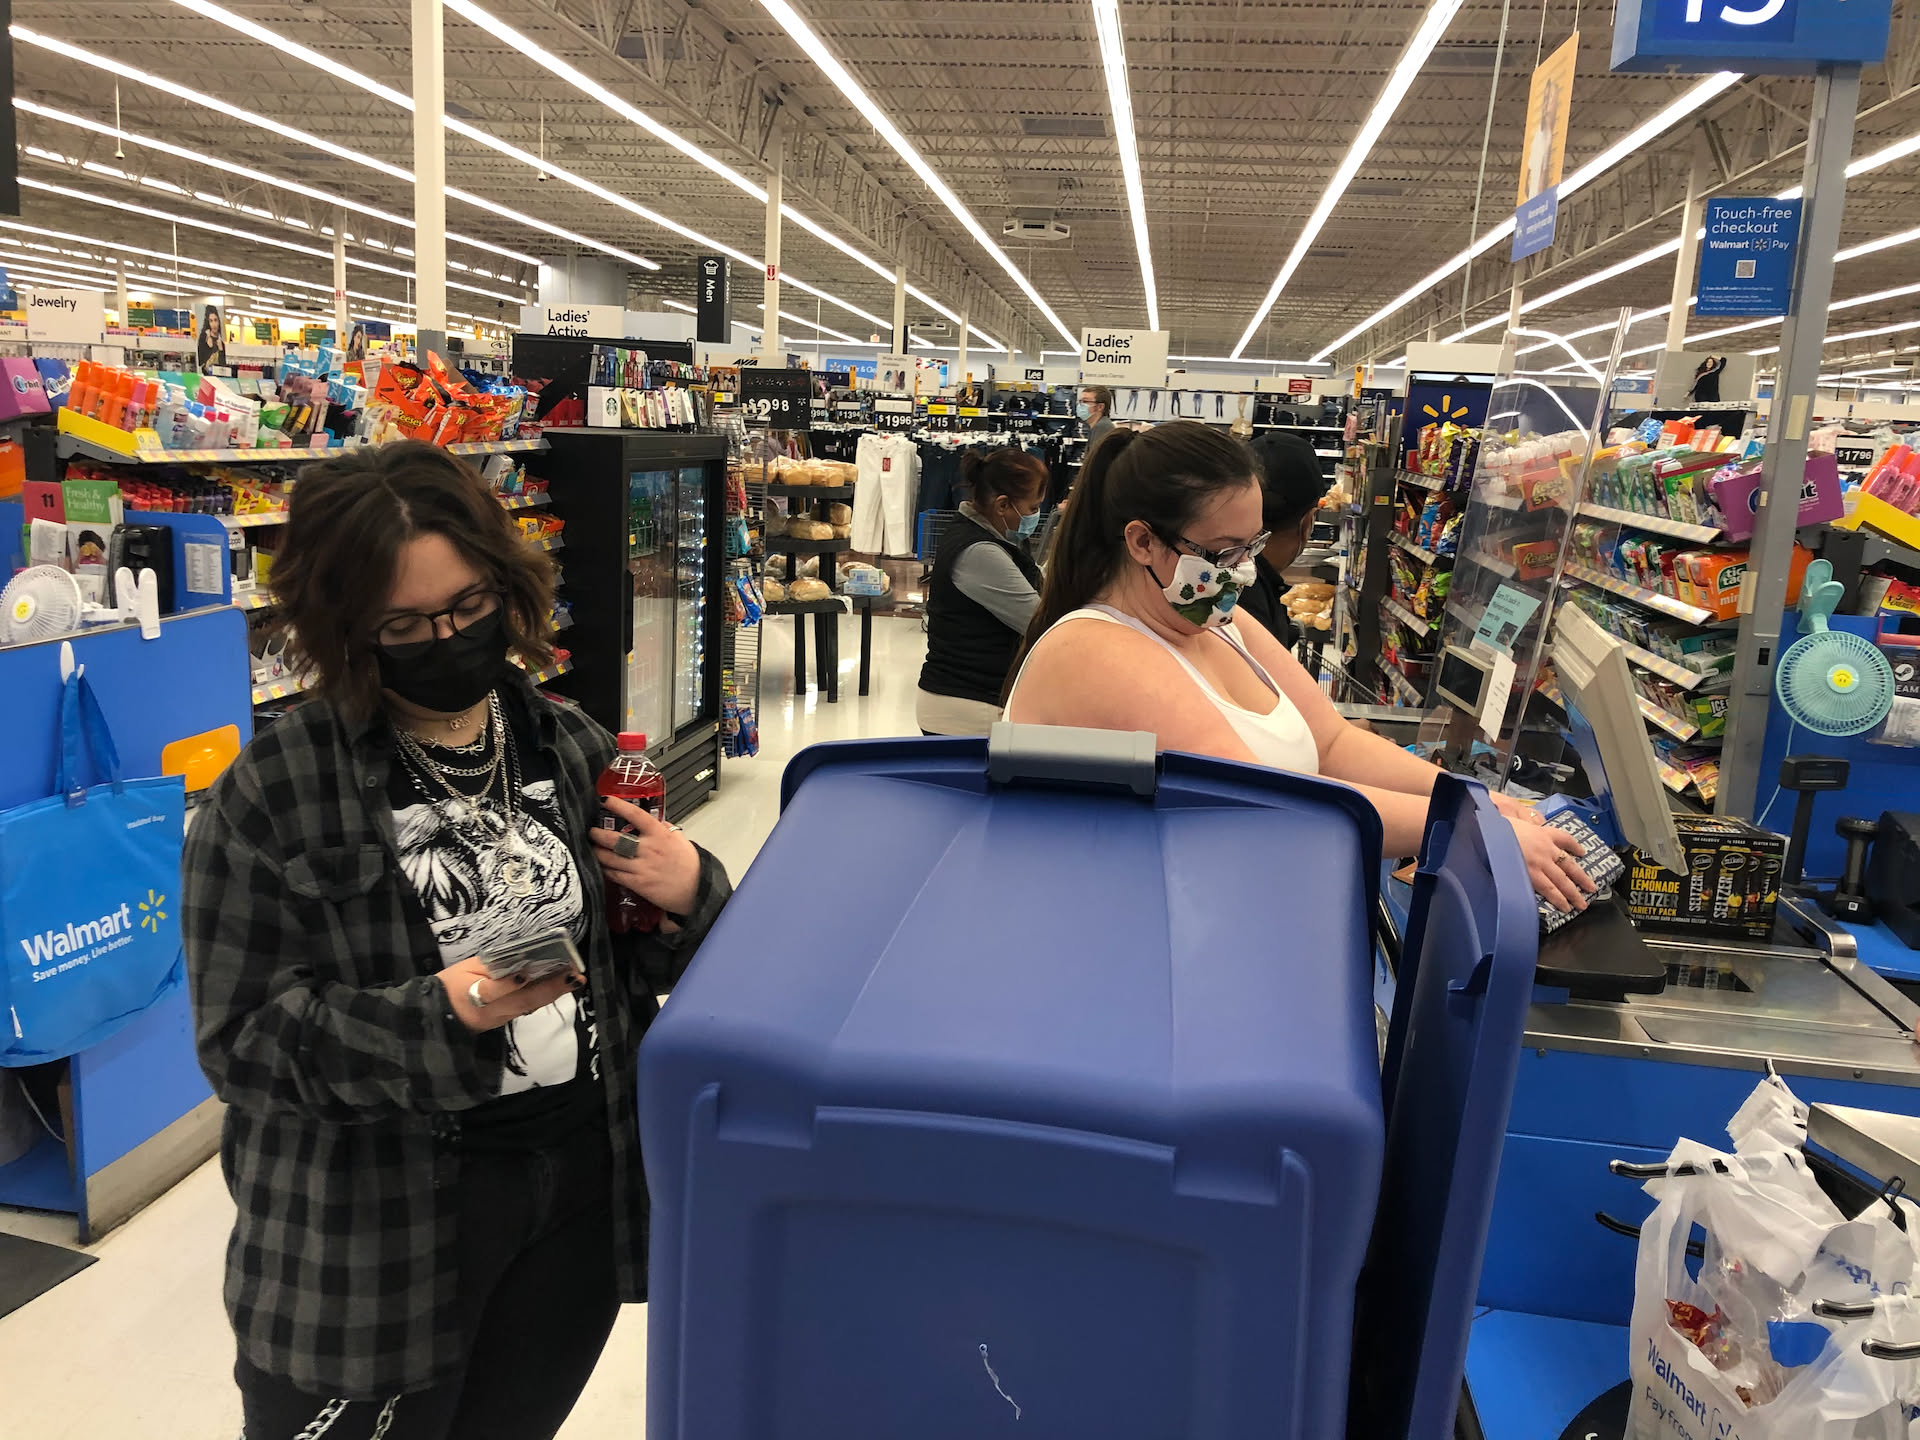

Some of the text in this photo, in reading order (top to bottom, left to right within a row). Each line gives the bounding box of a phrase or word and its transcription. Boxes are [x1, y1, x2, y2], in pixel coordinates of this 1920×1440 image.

[1713, 206, 1793, 219] Touch-free
[1711, 221, 1779, 234] checkout
[1709, 240, 1790, 251] Walmart Pay
[705, 278, 716, 303] Men
[30, 294, 77, 312] Jewelry
[547, 324, 589, 337] Active
[1085, 350, 1132, 365] Denim
[1026, 370, 1043, 380] Lee
[931, 416, 949, 429] $15
[961, 417, 973, 428] $7
[1838, 450, 1873, 462] $1796
[40, 493, 55, 508] 11
[65, 487, 101, 500] Fresh &
[66, 497, 106, 513] Healthy
[1895, 683, 1920, 694] EAM
[1710, 700, 1727, 714] ICE
[1631, 866, 1659, 880] HARD
[1630, 879, 1680, 894] LEMONADE
[1689, 871, 1704, 912] SELTZER
[1629, 890, 1680, 909] SELTZER
[1713, 872, 1734, 919] SELTZER
[1628, 905, 1677, 917] VARIETY PACK
[20, 902, 132, 967] Walmart
[32, 934, 134, 983] Save money. Live better.
[1647, 1336, 1707, 1427] Walmart
[1645, 1385, 1667, 1420] Pay
